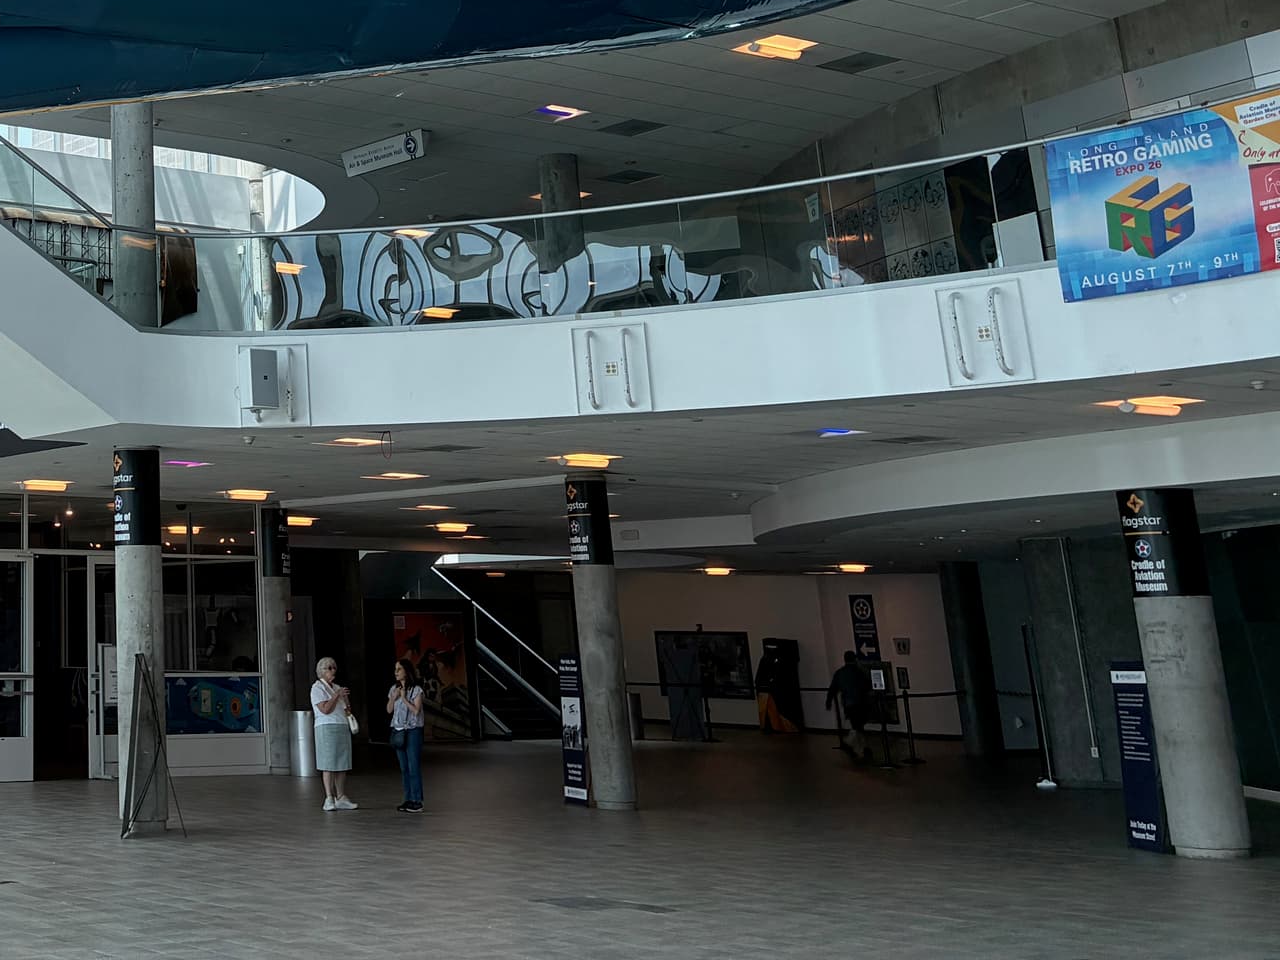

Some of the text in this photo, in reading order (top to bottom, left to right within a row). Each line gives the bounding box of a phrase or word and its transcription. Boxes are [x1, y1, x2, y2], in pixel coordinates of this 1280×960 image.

[1067, 122, 1209, 160] LONG ISLAND
[1069, 133, 1213, 175] RETRO GAMING
[1243, 146, 1267, 162] Only
[1115, 160, 1162, 177] EXPO 26
[1082, 266, 1157, 289] AUGUST
[1167, 260, 1192, 277] 7TH
[1214, 252, 1239, 269] 9TH
[113, 474, 134, 486] gstar
[567, 501, 588, 512] gstar
[1131, 559, 1165, 570] Cradle of
[1134, 570, 1165, 581] Aviation
[1135, 581, 1168, 592] Museum
